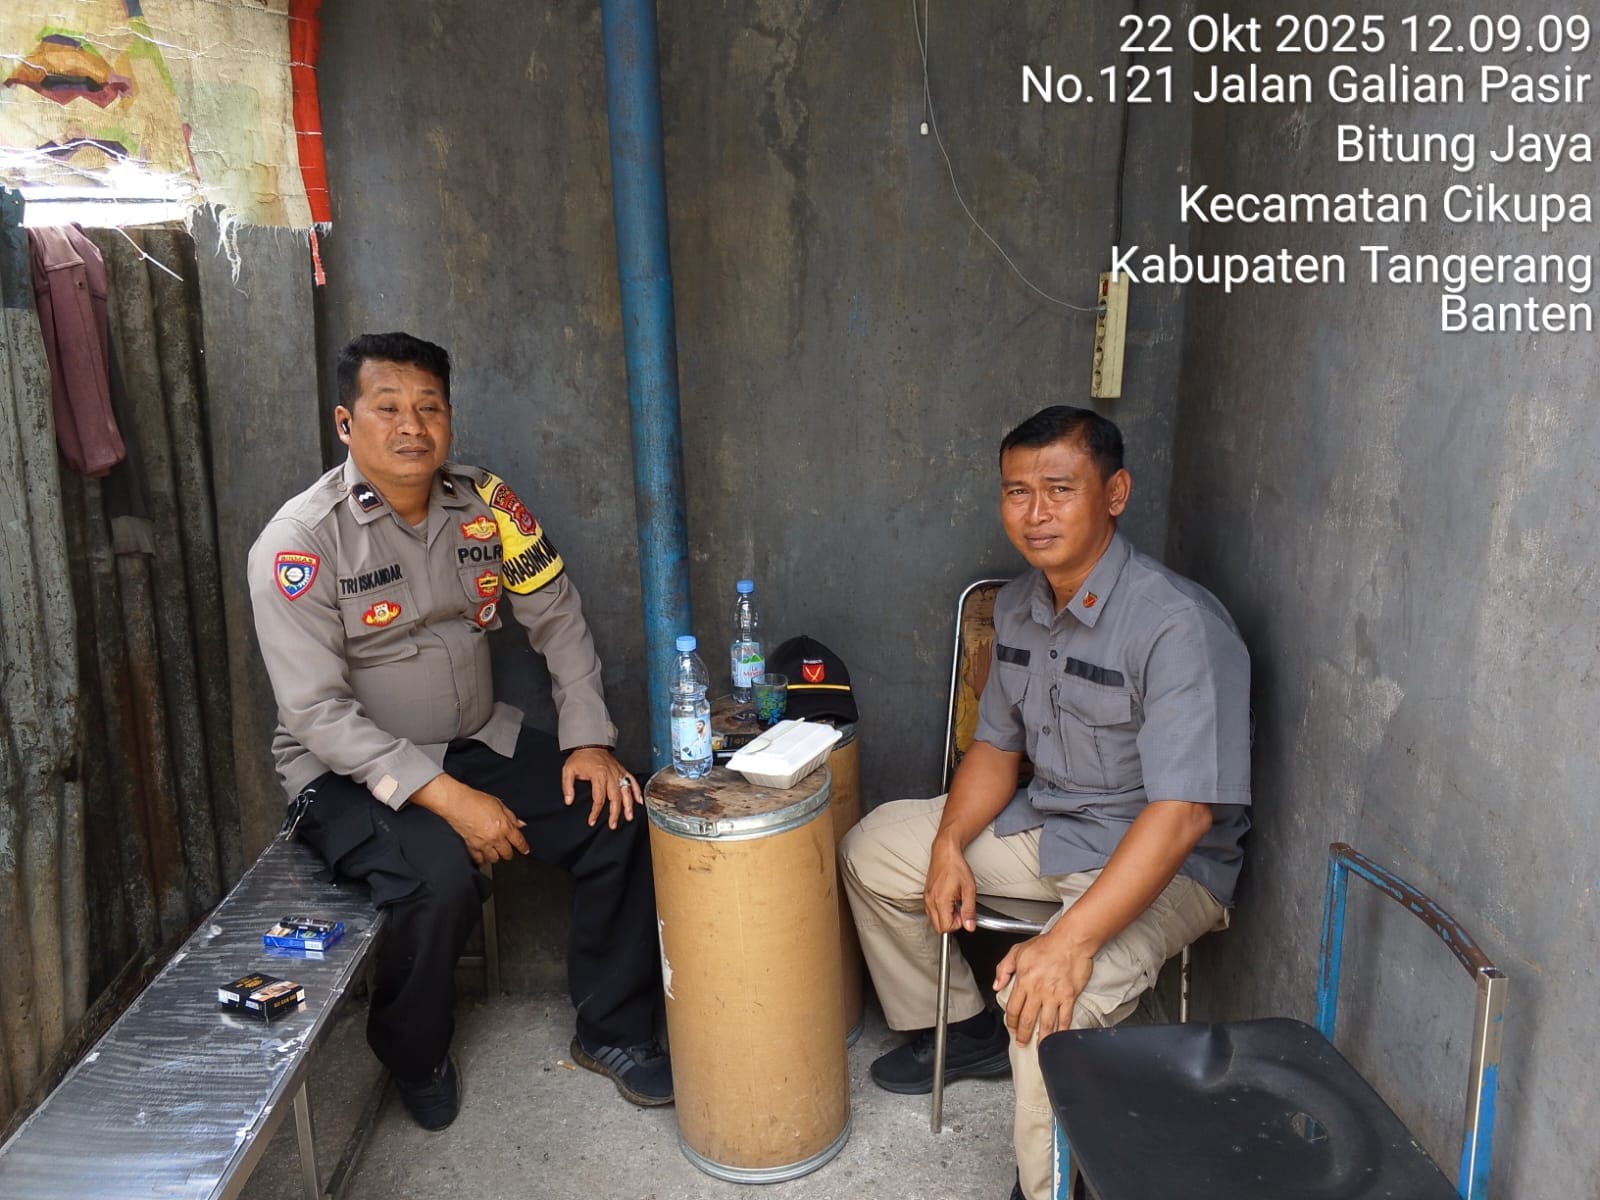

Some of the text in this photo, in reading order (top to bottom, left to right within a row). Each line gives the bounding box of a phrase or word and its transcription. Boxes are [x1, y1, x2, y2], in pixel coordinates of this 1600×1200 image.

[457, 544, 503, 564] POLR
[339, 563, 403, 595] TRI ISKANDAR
